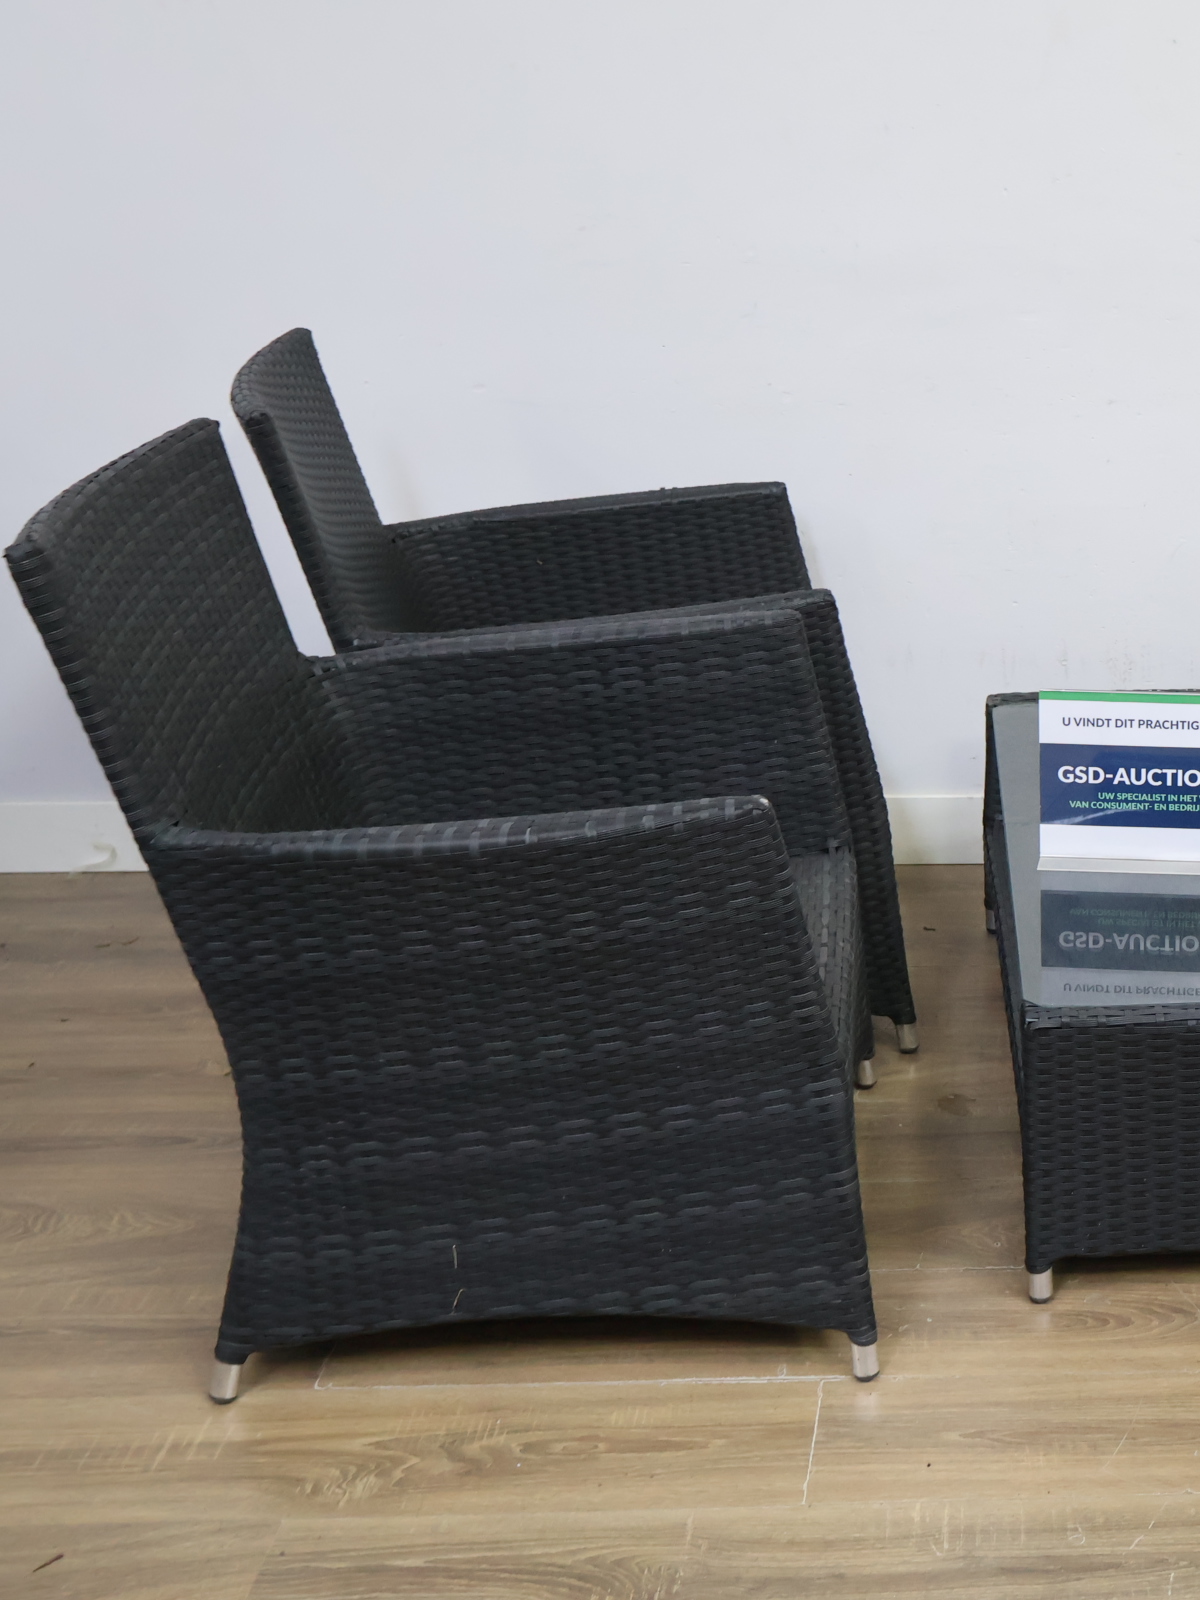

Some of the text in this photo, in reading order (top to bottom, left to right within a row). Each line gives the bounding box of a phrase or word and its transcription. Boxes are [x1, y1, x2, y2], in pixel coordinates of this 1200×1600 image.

[1062, 717, 1071, 726] U
[1073, 718, 1112, 728] VINDT
[1115, 719, 1135, 728] DIT
[1117, 793, 1166, 801] SPECIALIST
[1069, 801, 1089, 809] VAN
[1091, 801, 1152, 810] CONSUMENT-
